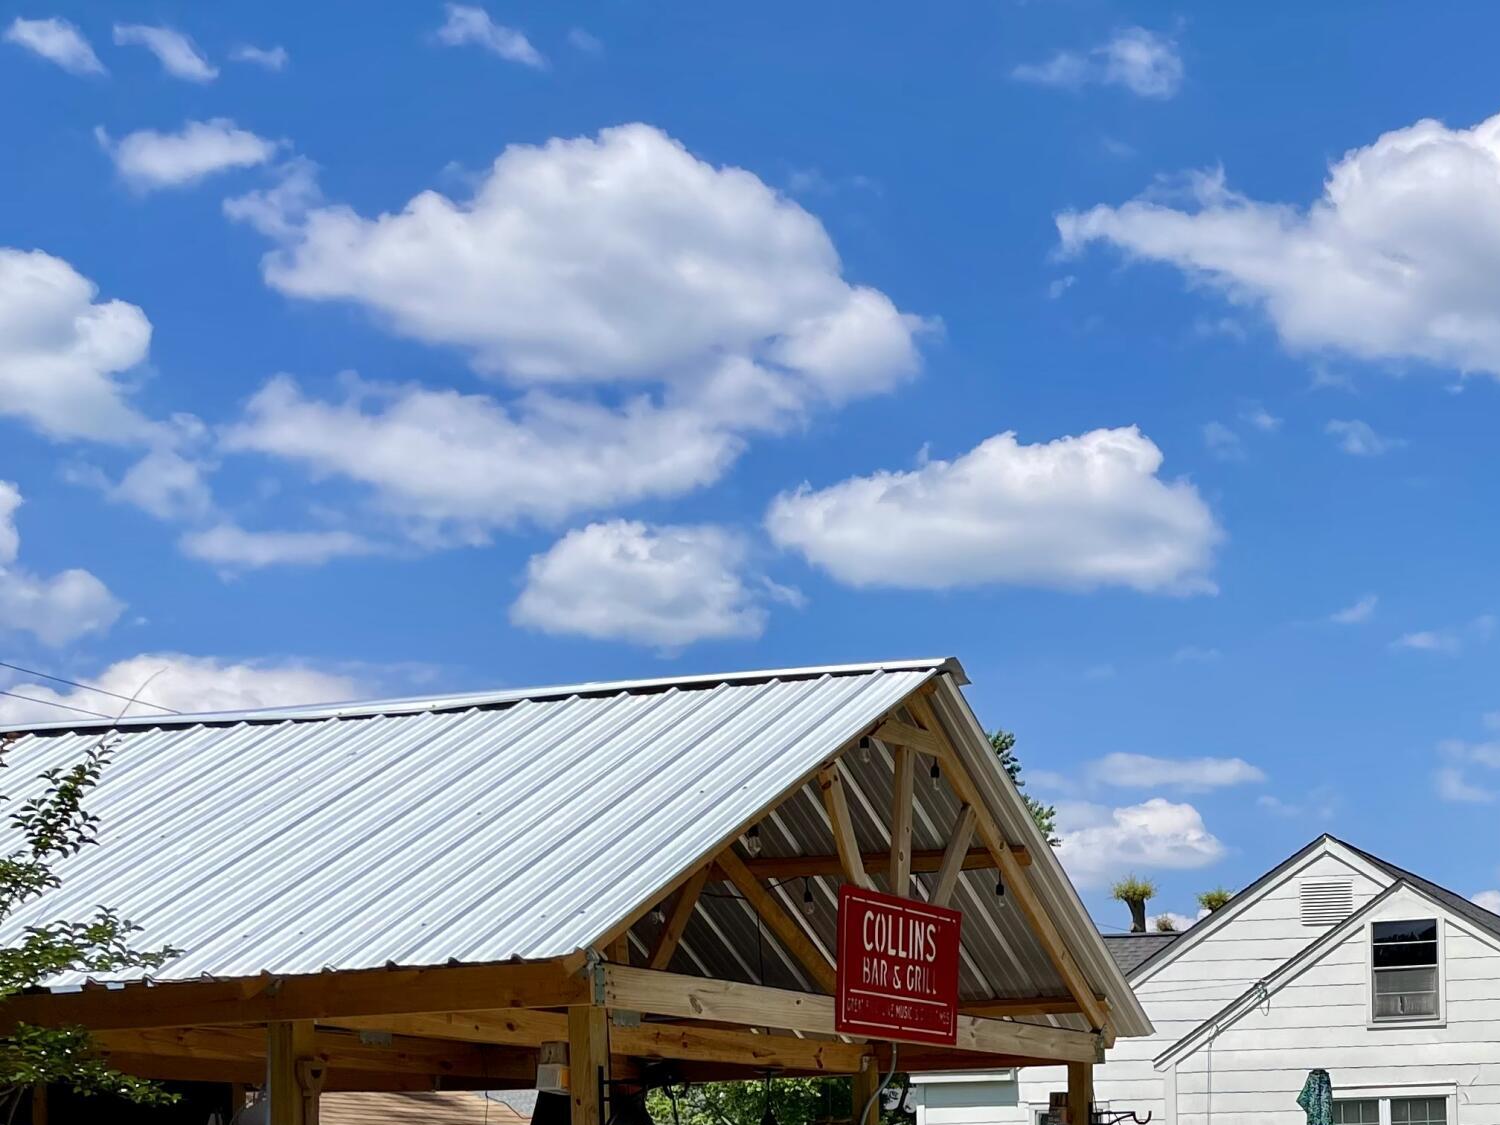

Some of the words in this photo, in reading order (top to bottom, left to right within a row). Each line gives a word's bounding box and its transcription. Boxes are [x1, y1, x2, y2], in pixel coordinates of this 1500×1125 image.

[863, 956, 888, 987] BAR
[892, 965, 902, 990] &
[906, 965, 937, 995] GRILL
